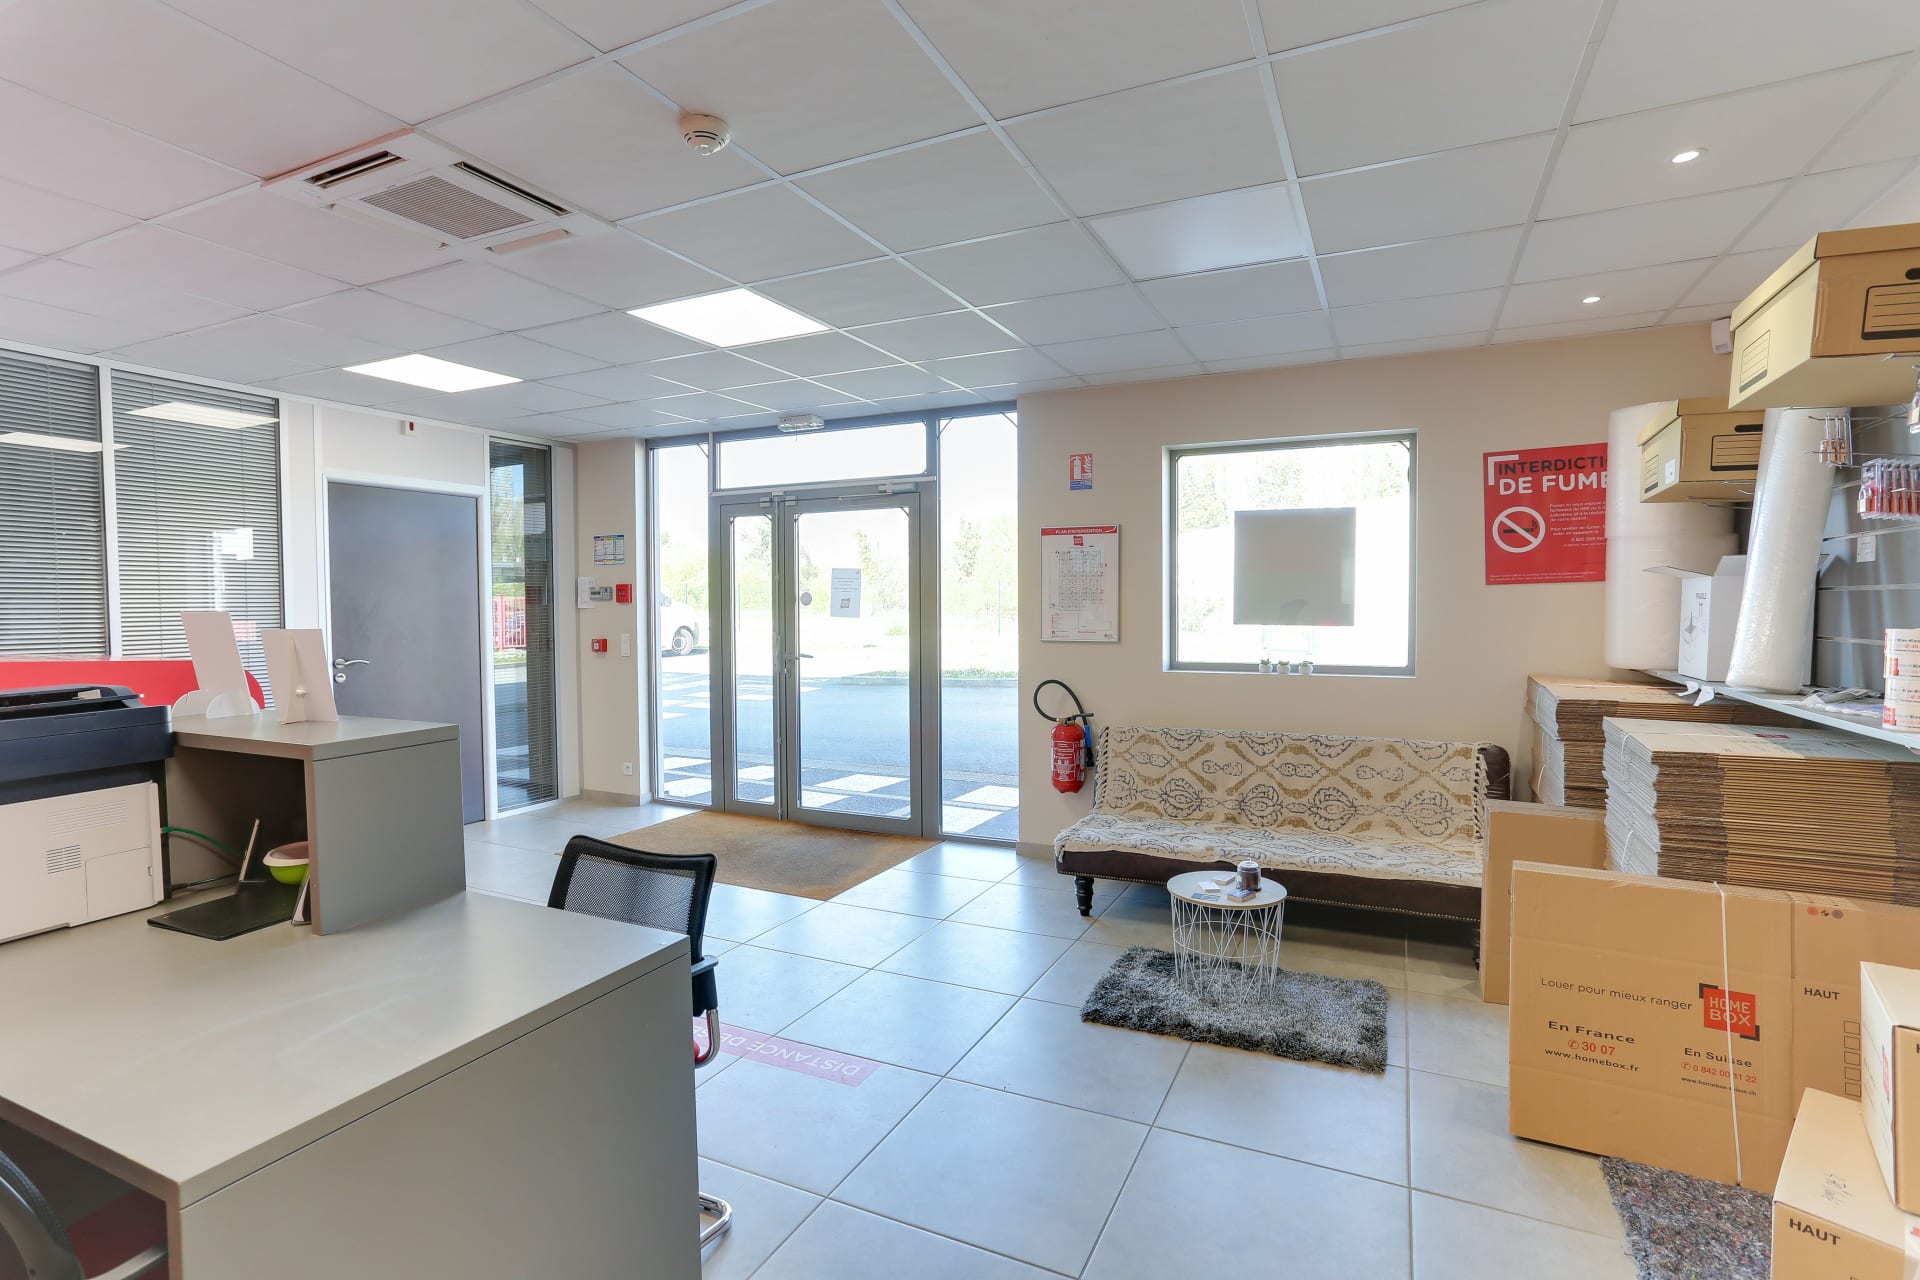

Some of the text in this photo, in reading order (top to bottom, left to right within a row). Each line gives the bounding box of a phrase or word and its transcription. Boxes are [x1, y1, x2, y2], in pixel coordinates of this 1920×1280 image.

[1498, 456, 1608, 475] INTERDICTI
[1499, 477, 1533, 496] DE
[1541, 977, 1693, 1010] Louer pour mieux ranger
[1804, 987, 1840, 1001] HAUT
[1709, 996, 1751, 1014] HOME
[1709, 1009, 1751, 1027] BOX
[1548, 1020, 1636, 1044] En France
[720, 1033, 863, 1077] DISTANCE DE
[1582, 1042, 1616, 1056] 30 07
[1684, 1047, 1701, 1058] En
[1544, 1048, 1640, 1072] www.homebox.fr
[1788, 1217, 1841, 1246] HAUT
